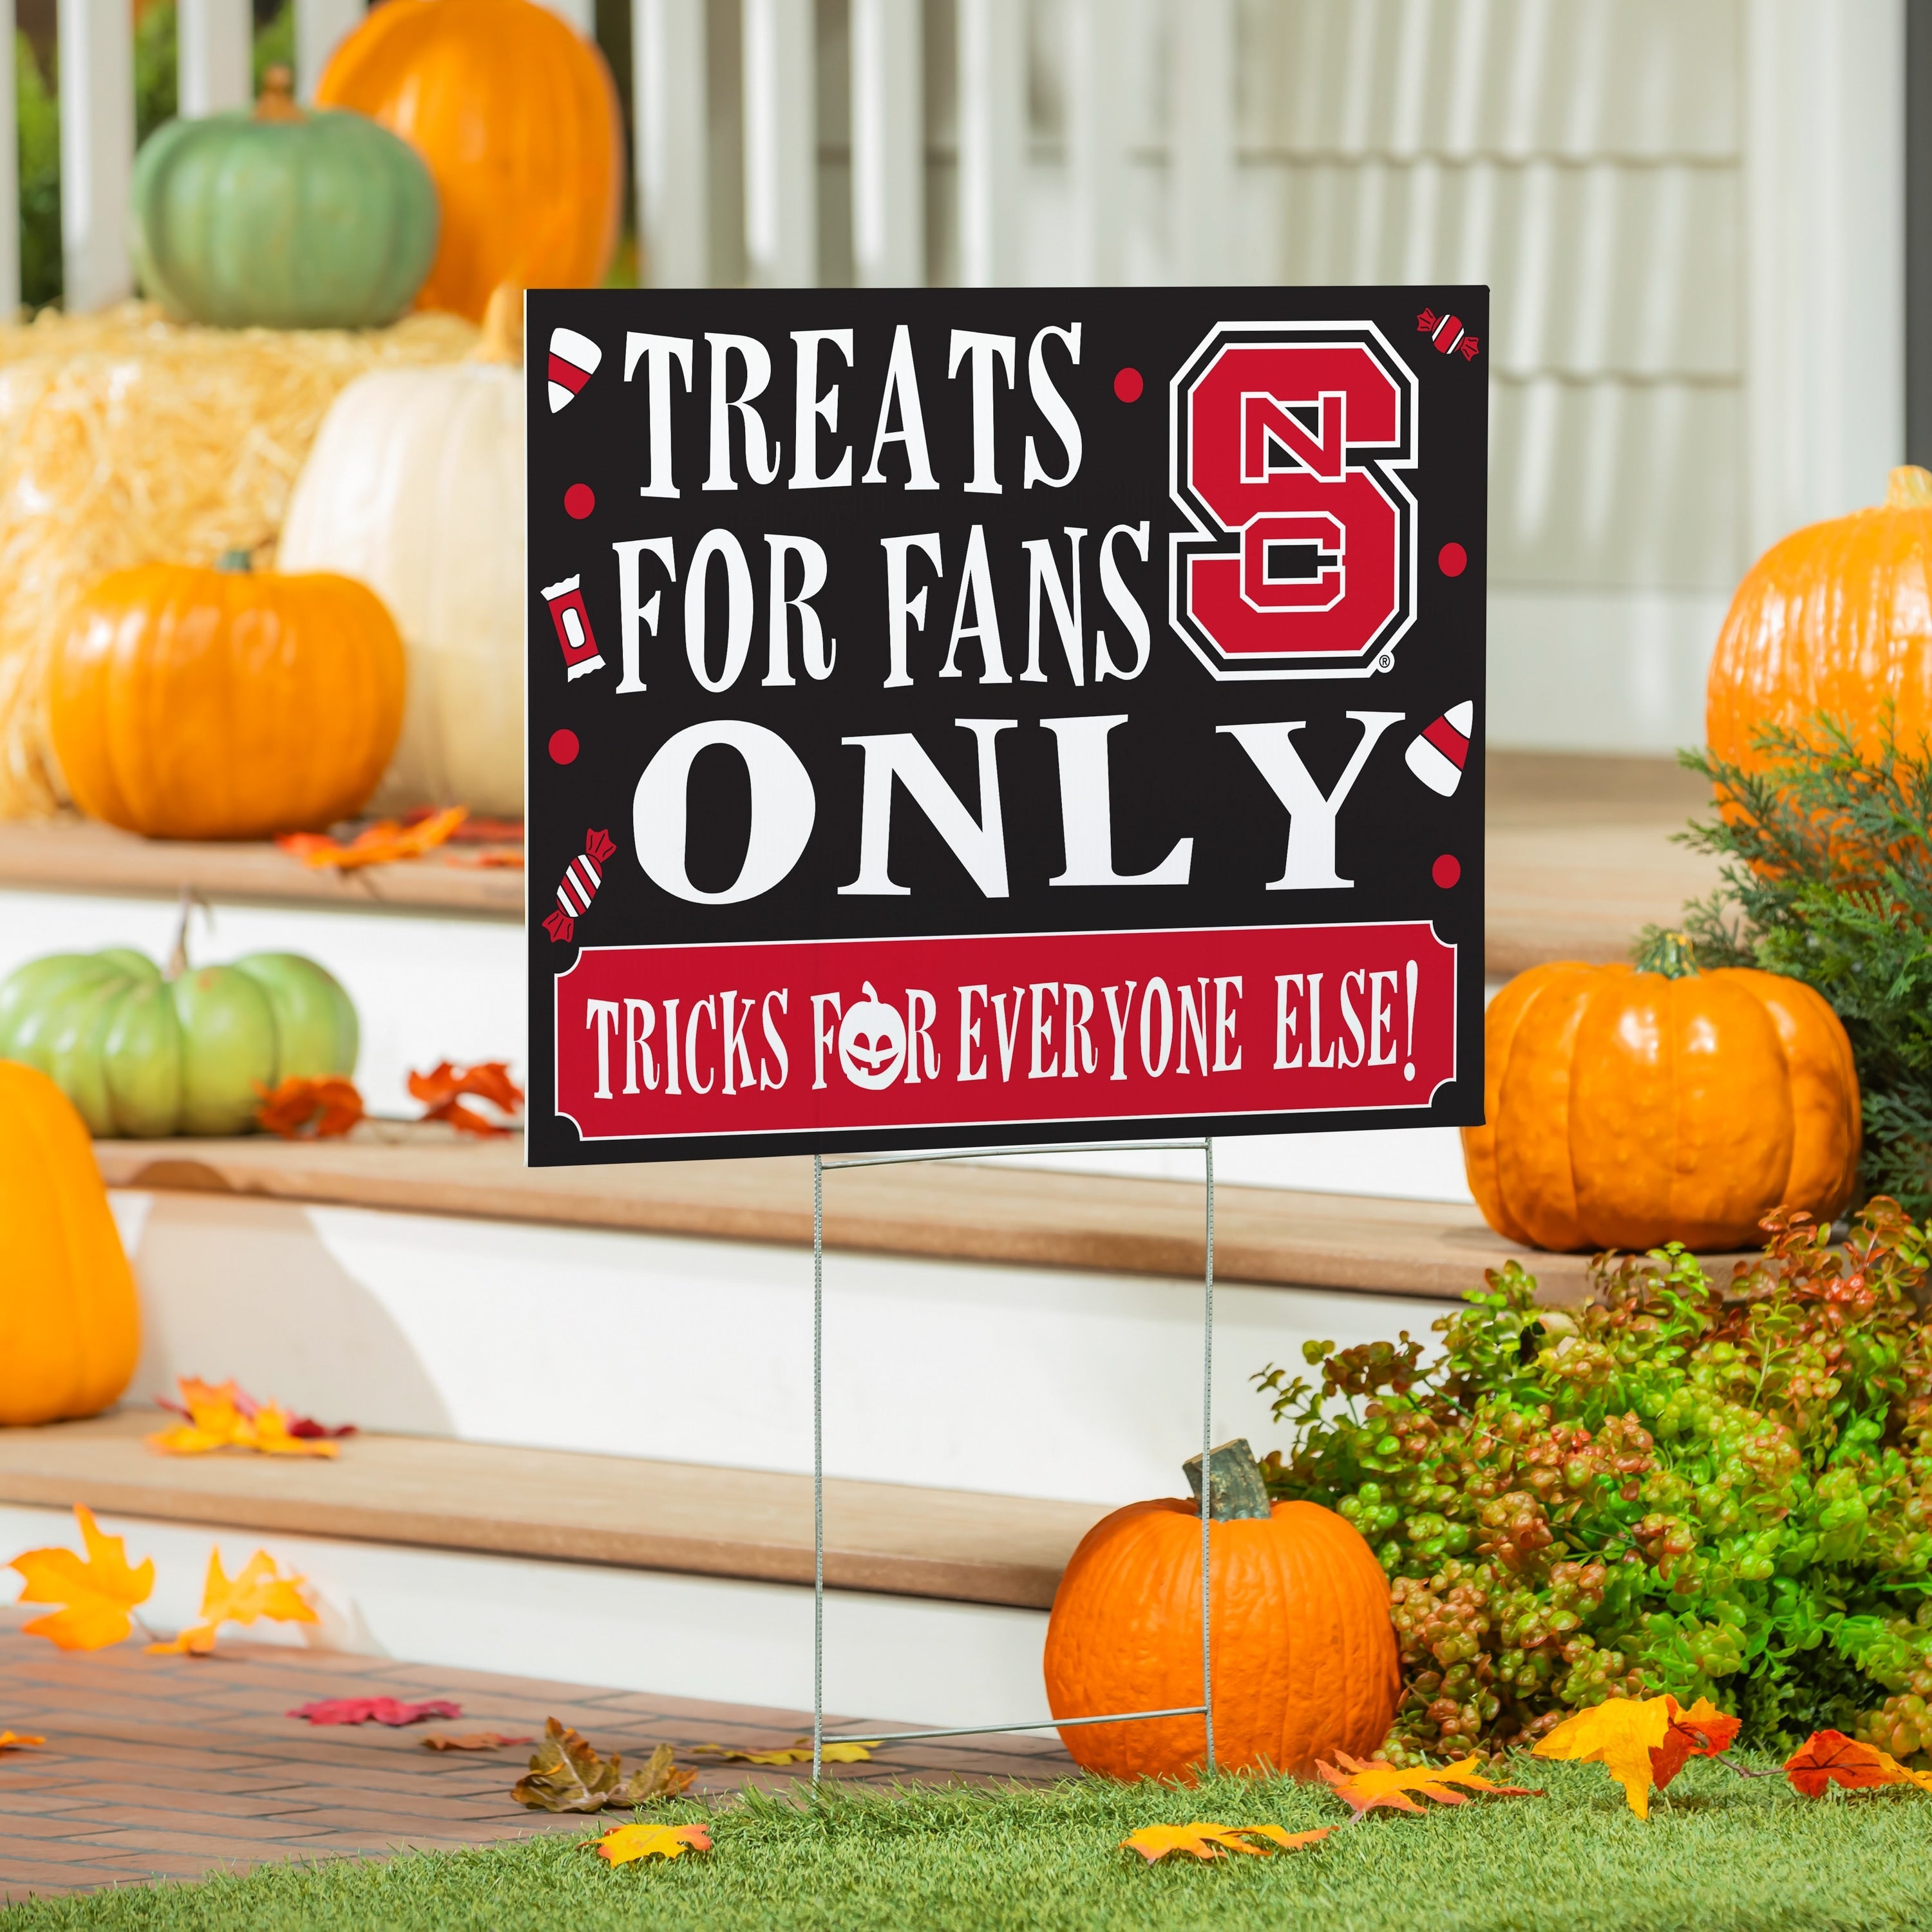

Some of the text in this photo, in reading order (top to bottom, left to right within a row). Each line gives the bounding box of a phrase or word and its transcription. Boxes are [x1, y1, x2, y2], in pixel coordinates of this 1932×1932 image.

[623, 322, 1083, 499] TREATS
[612, 520, 1151, 694] FOR FANS
[632, 710, 1406, 905] ONLY
[586, 988, 789, 1099] TRICKS
[957, 975, 1243, 1083] EVERYONE
[1273, 960, 1418, 1081] ELSE!
